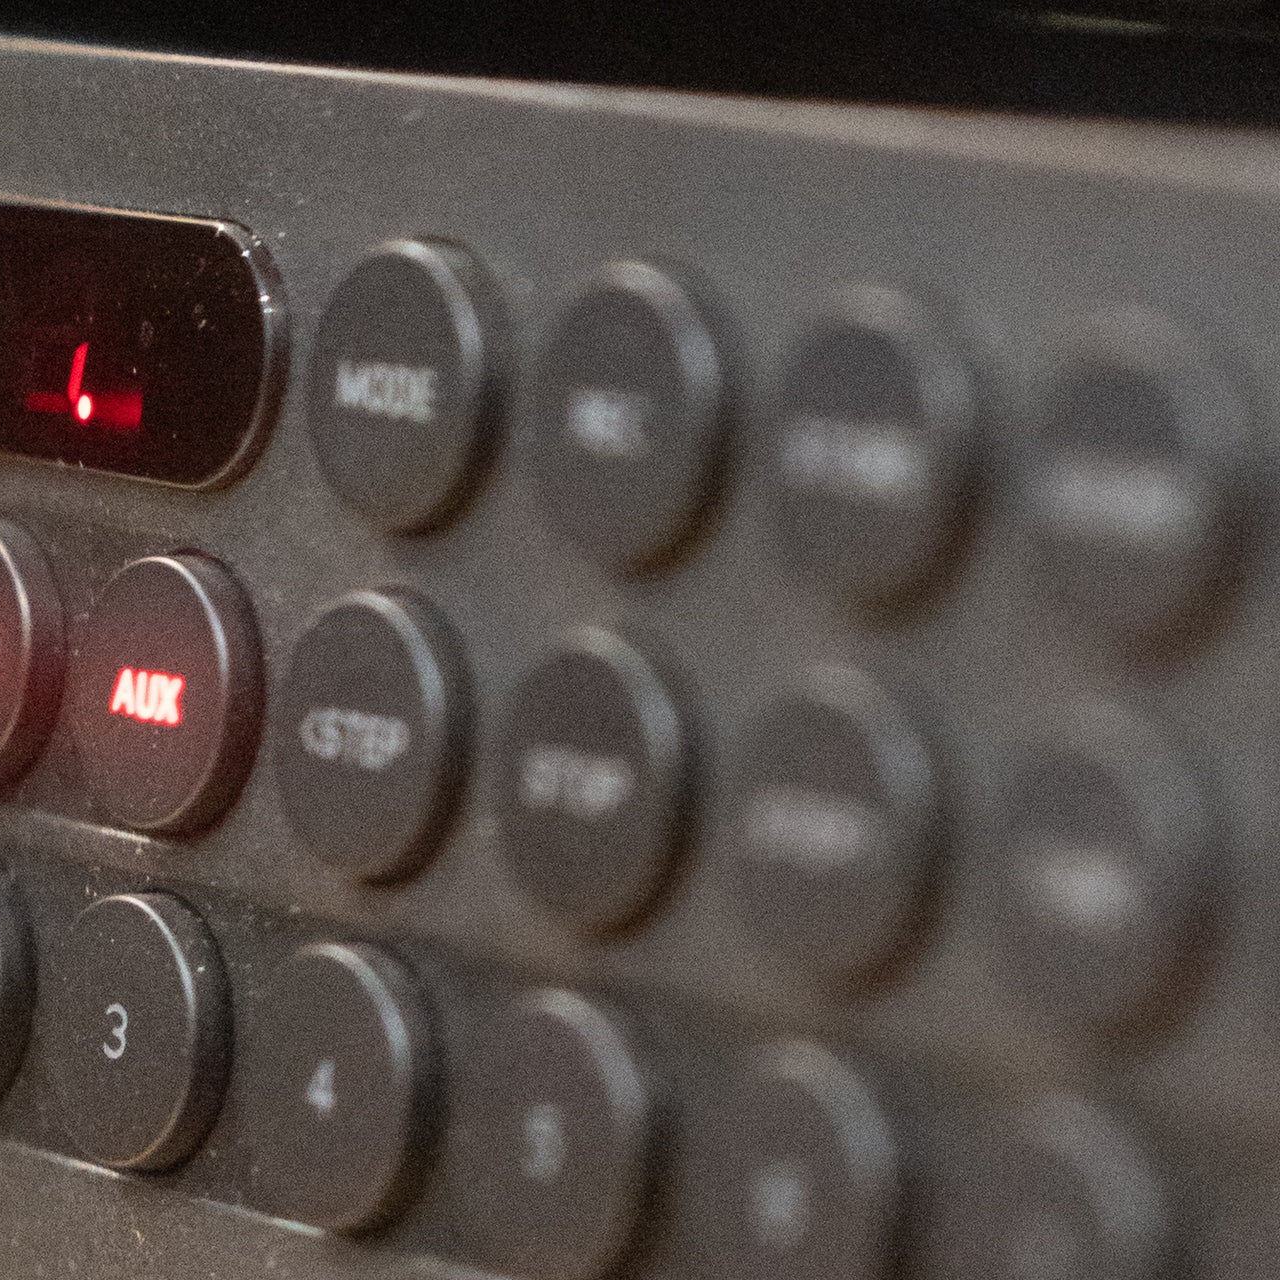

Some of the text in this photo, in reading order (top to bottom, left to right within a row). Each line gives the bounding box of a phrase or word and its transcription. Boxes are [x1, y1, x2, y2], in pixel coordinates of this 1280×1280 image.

[335, 362, 435, 424] MODE
[109, 666, 186, 727] AUX
[103, 1003, 128, 1059] 3
[306, 1060, 335, 1113] 4
